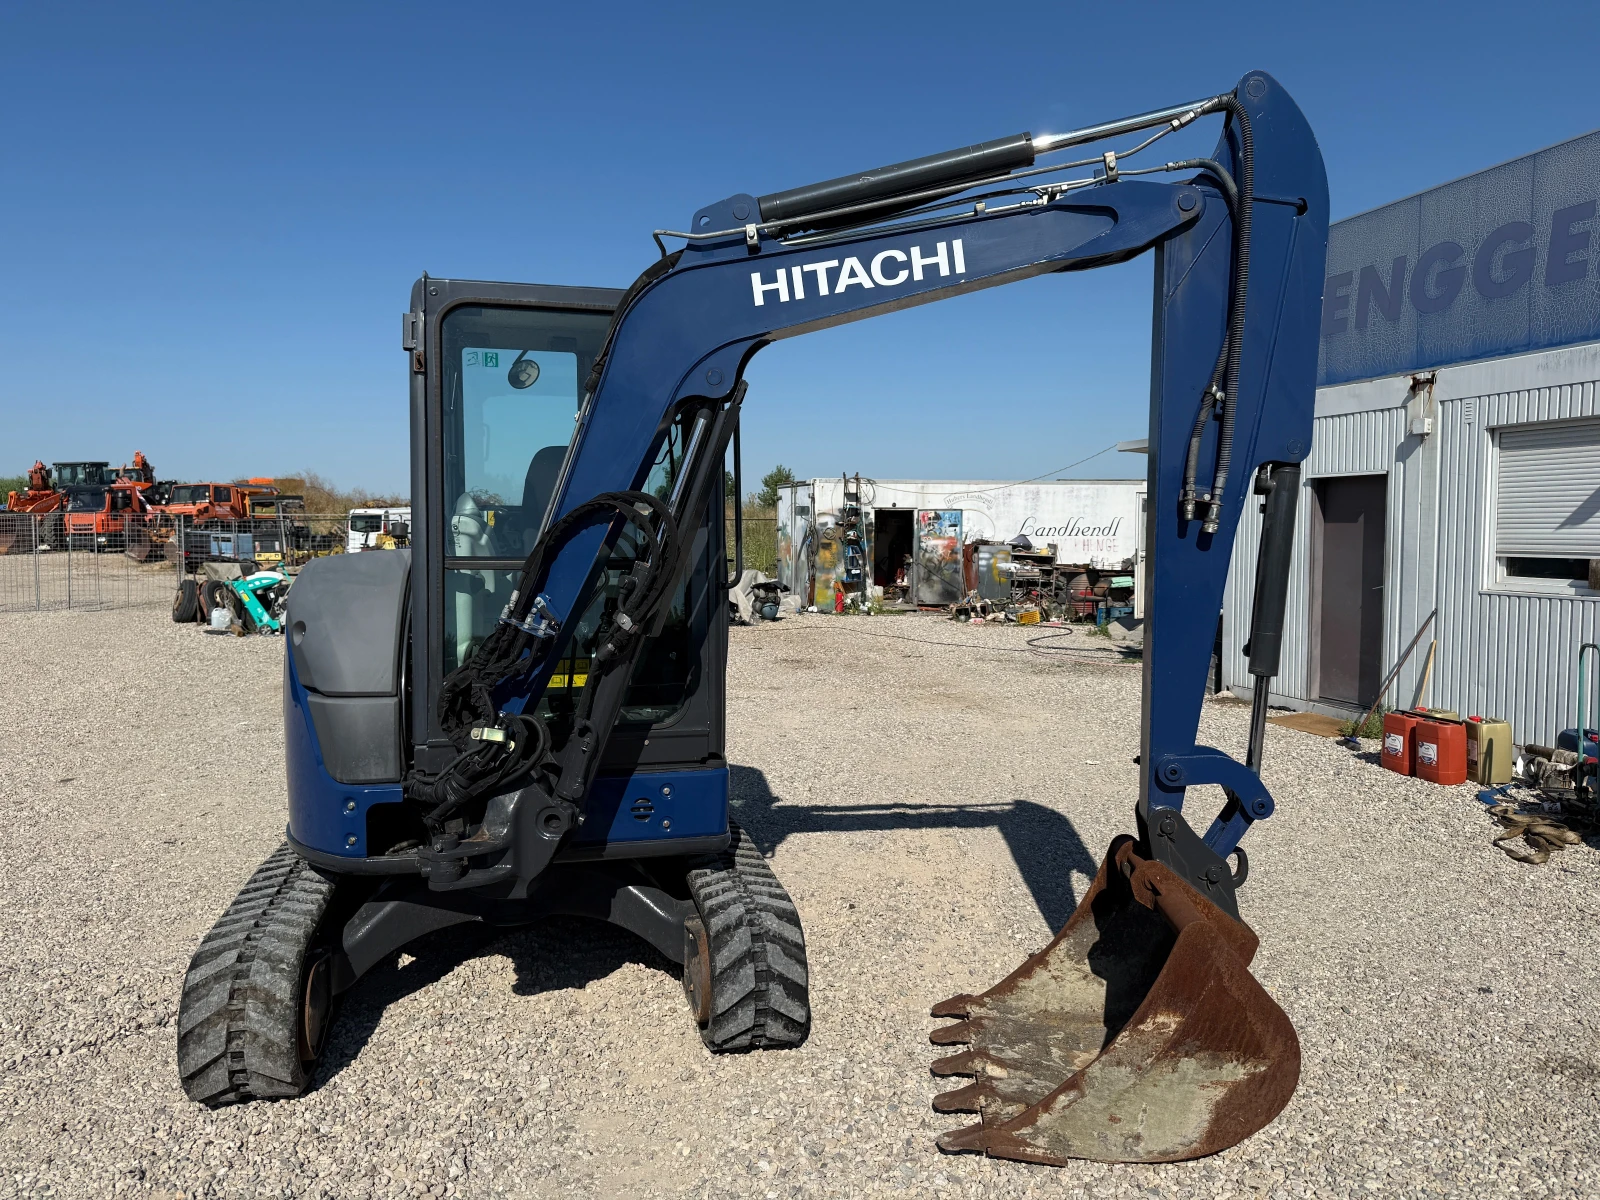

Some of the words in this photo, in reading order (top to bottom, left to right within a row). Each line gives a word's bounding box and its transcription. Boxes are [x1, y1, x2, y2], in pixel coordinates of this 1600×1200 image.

[751, 238, 966, 307] HITACHI
[1320, 200, 1600, 336] ENGGE
[1018, 516, 1124, 537] Landhendl
